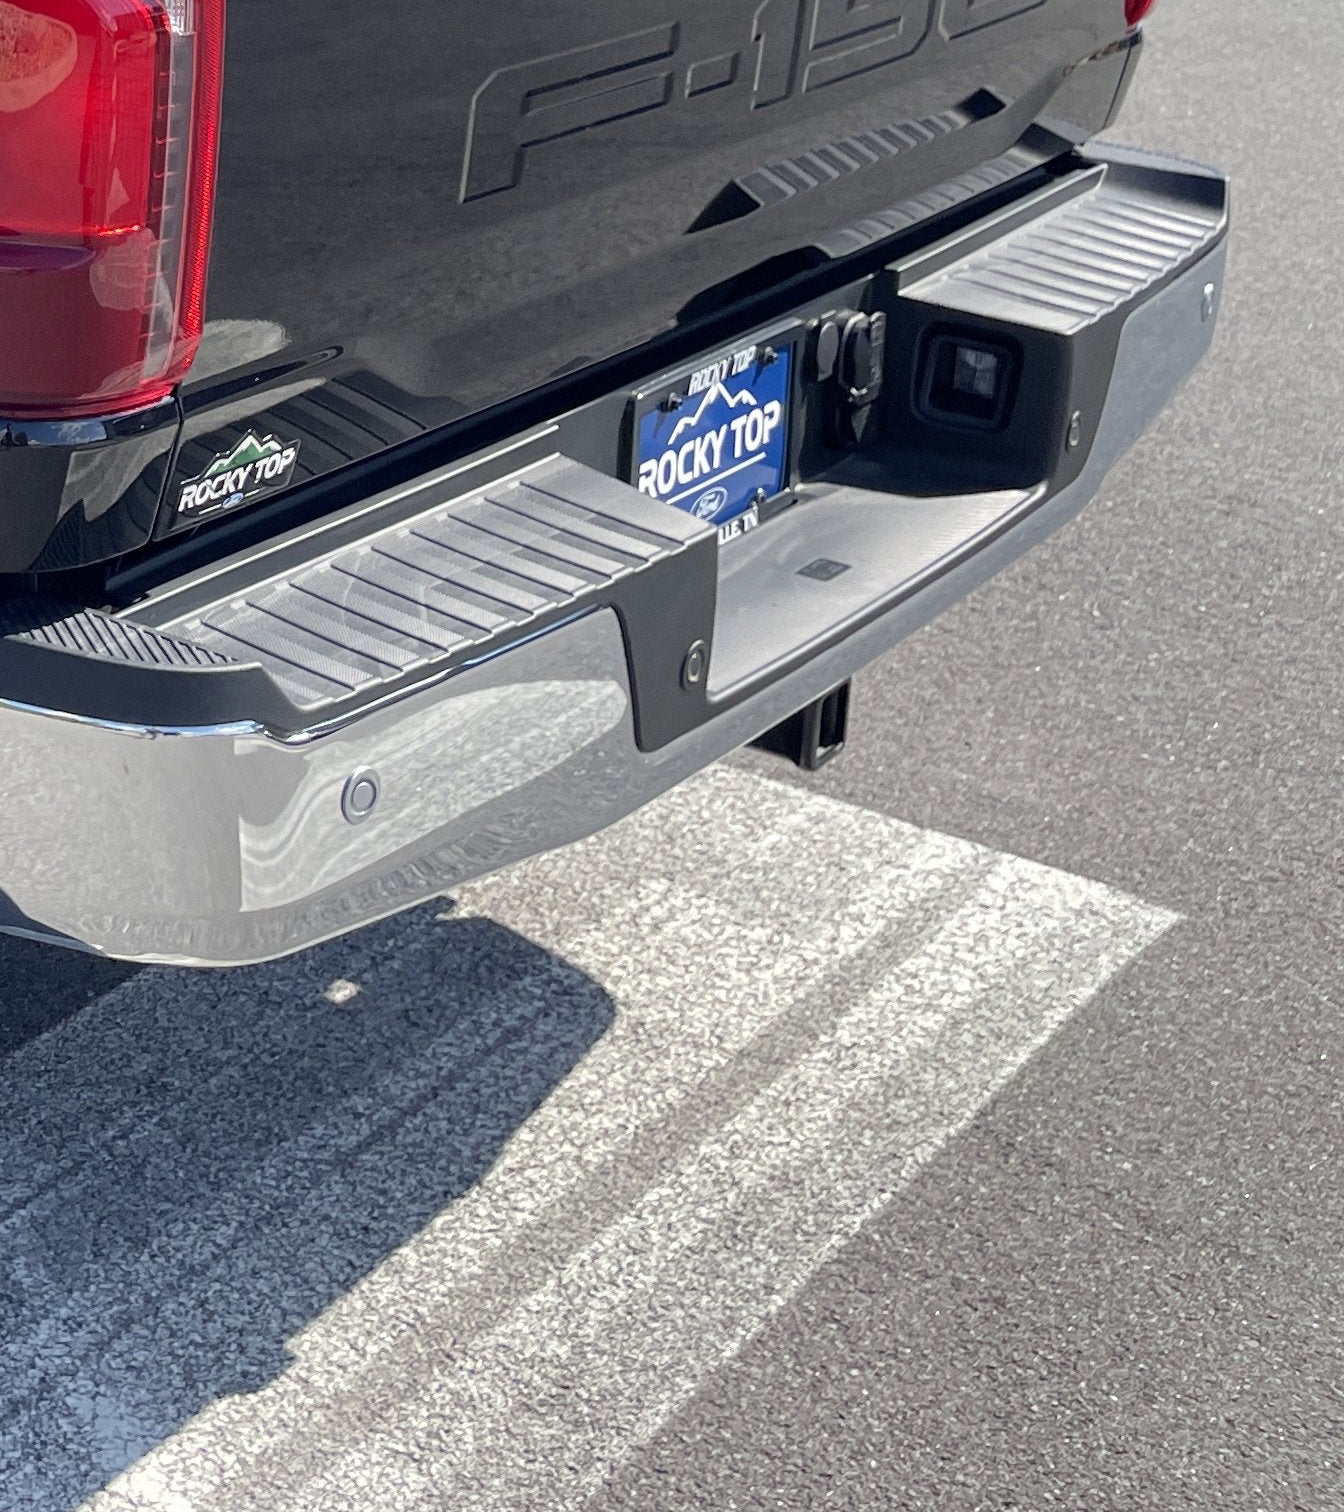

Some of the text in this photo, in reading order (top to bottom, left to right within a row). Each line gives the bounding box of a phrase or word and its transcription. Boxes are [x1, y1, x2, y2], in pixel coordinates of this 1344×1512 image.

[688, 345, 757, 396] ROCKY TOP
[638, 399, 781, 499] ROCKY TOP
[177, 463, 255, 513] ROCKY
[254, 447, 297, 484] TOP
[717, 519, 742, 546] LLE
